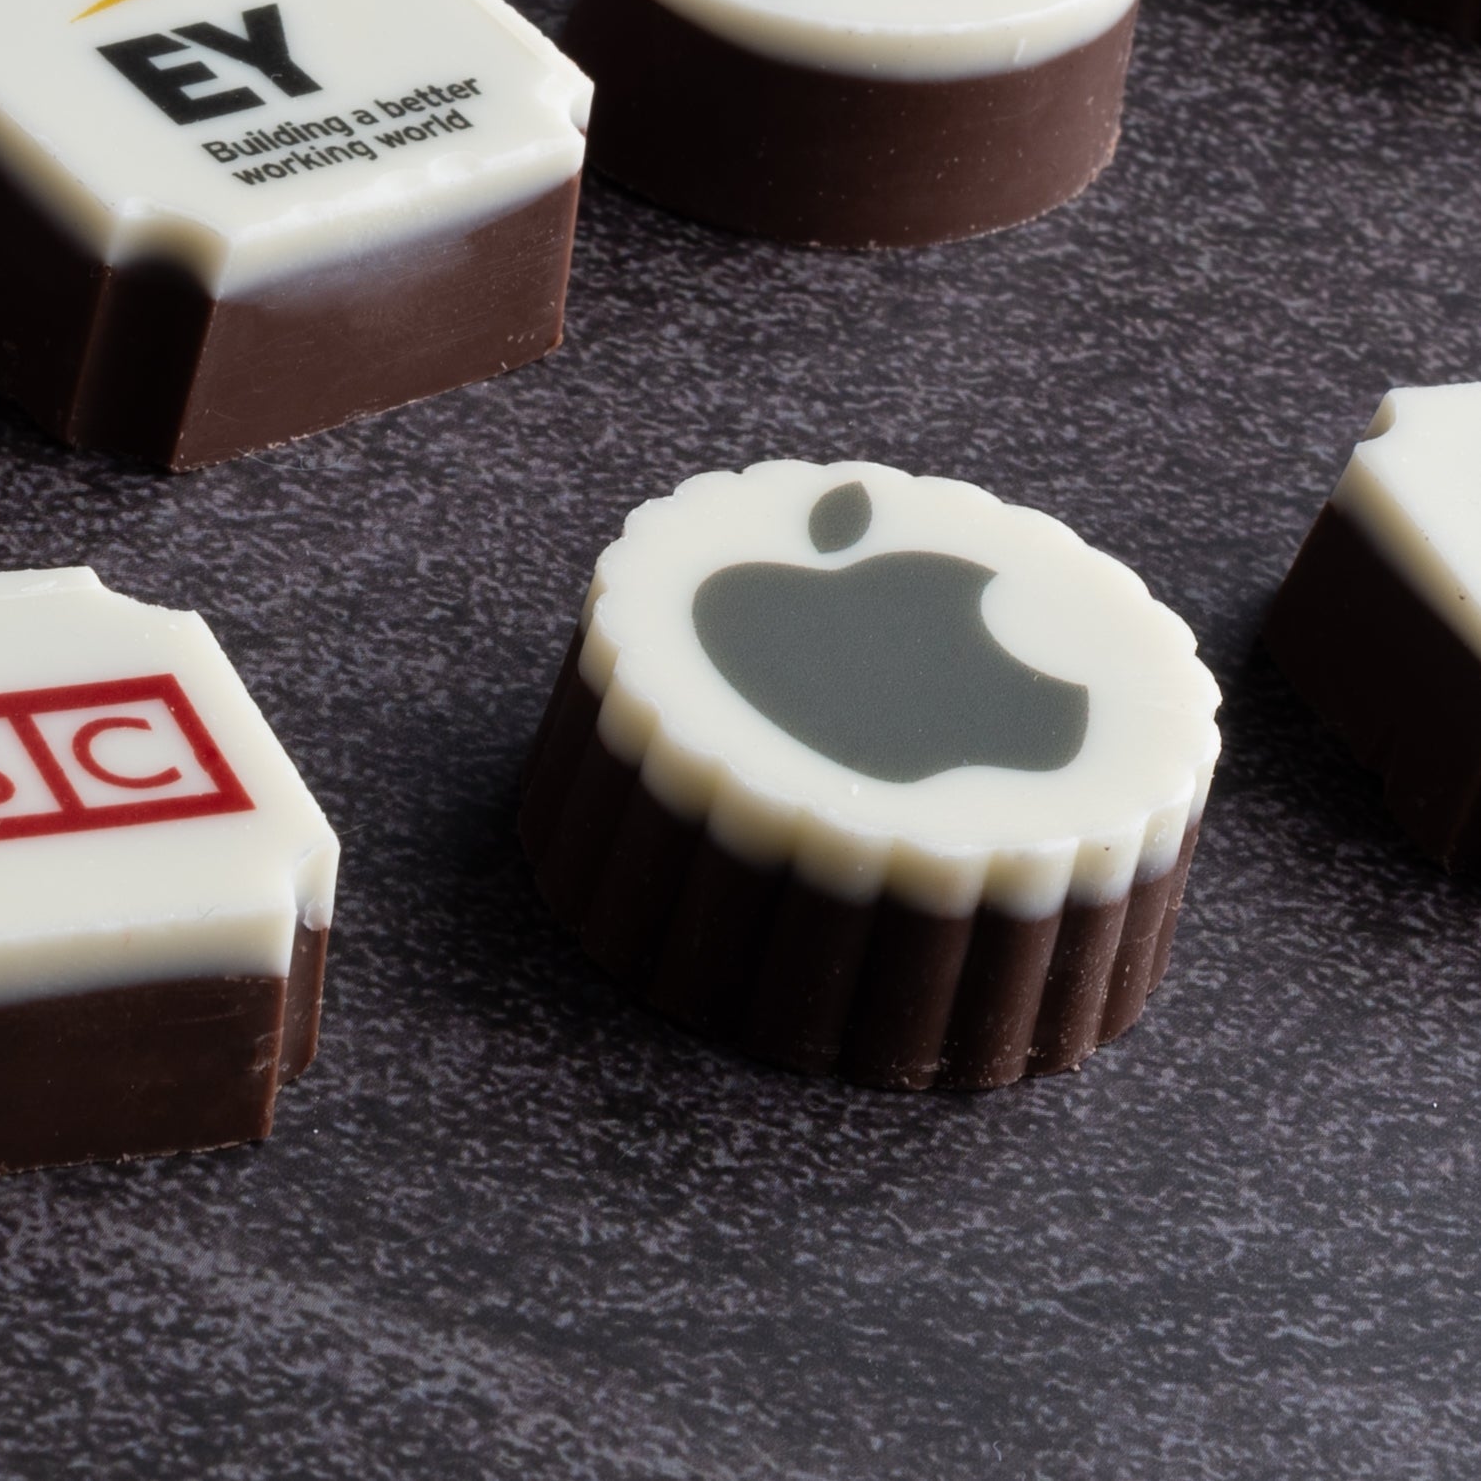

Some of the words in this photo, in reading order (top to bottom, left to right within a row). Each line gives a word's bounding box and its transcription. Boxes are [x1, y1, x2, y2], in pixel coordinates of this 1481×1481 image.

[96, 3, 323, 125] EY
[201, 115, 353, 164] Building
[351, 108, 377, 126] a
[379, 77, 482, 118] better
[232, 139, 378, 186] working
[375, 108, 474, 149] world
